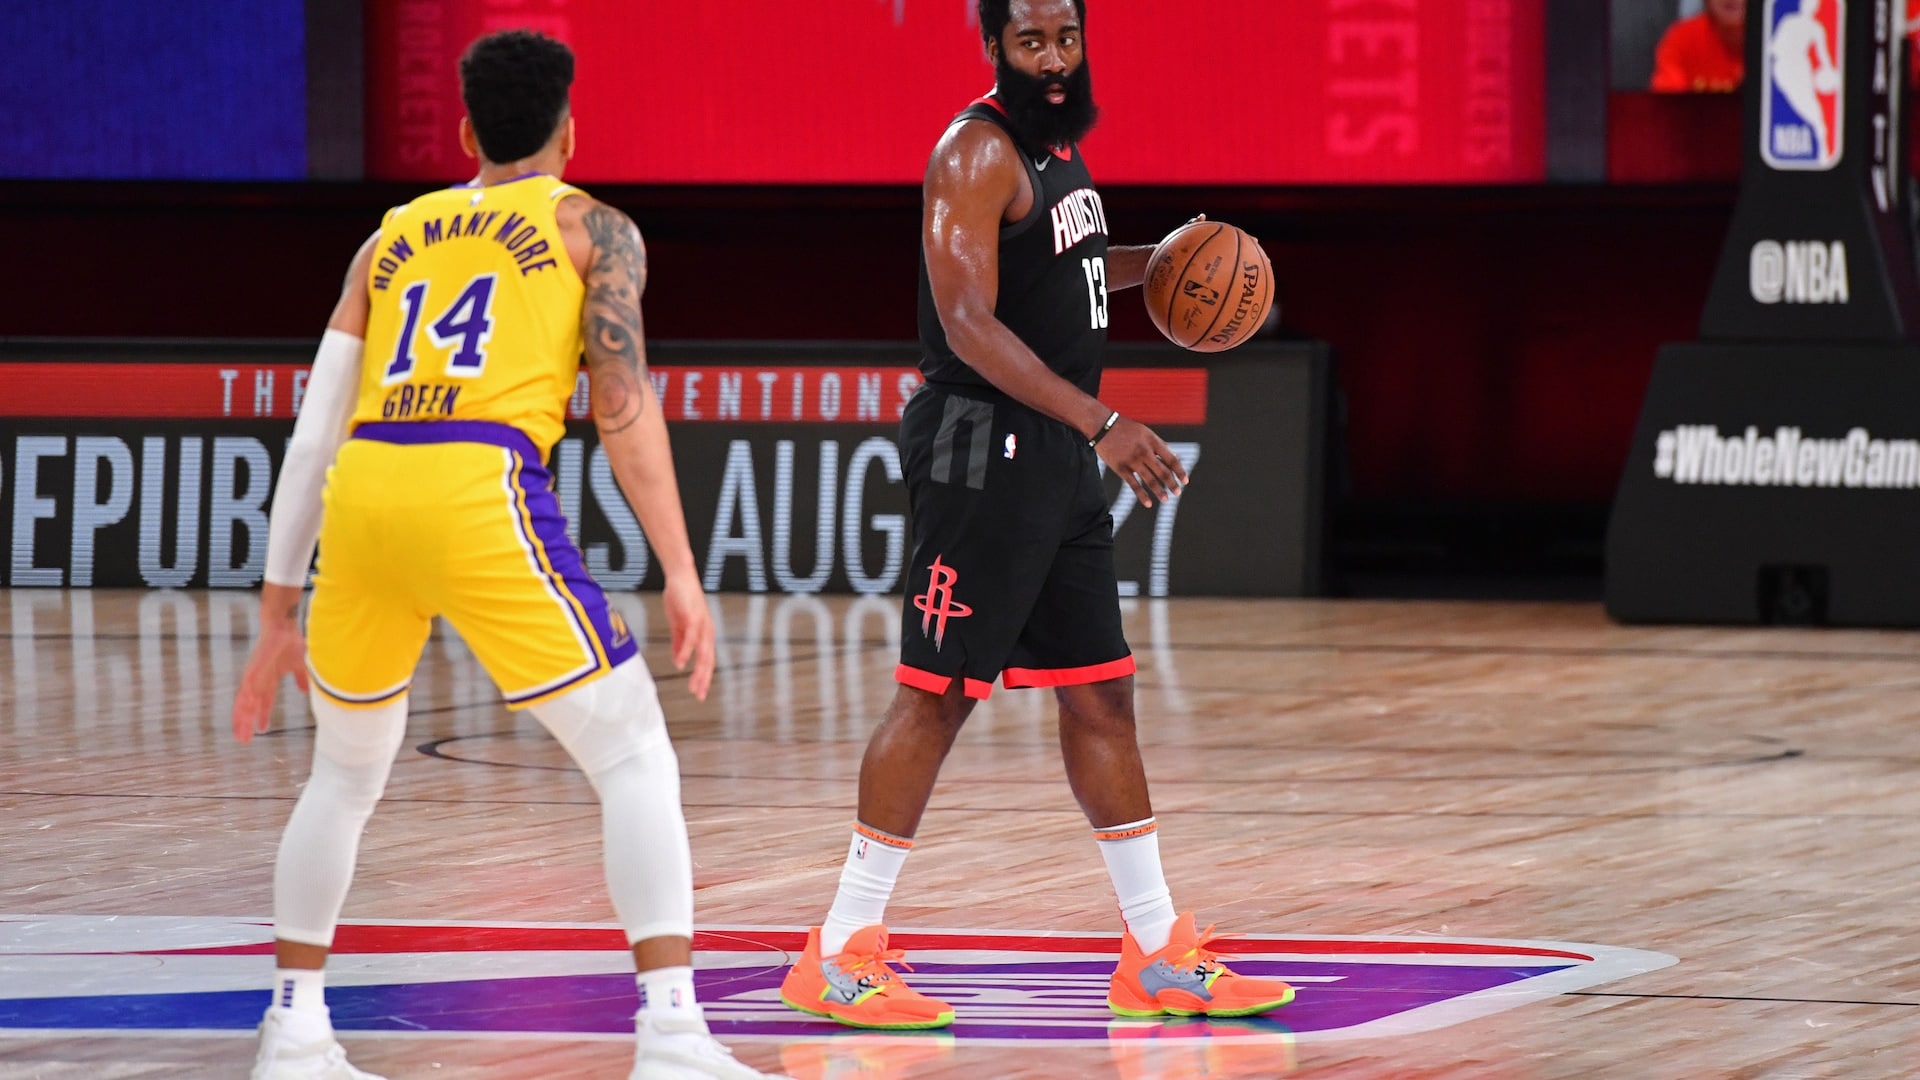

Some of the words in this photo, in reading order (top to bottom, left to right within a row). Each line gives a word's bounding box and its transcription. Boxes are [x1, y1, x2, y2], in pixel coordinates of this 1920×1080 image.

[1773, 124, 1813, 156] NBA
[373, 235, 415, 291] HOW
[424, 209, 502, 247] MANY
[493, 211, 558, 277] MORE
[1050, 188, 1109, 256] HOUSTO
[1081, 256, 1109, 330] 13
[1210, 261, 1259, 345] SPALDING
[1750, 240, 1849, 304] @NBA
[380, 272, 498, 387] 14
[383, 384, 461, 418] GREEN
[1654, 424, 1920, 489] #WholeNewGam
[702, 436, 906, 594] AUG
